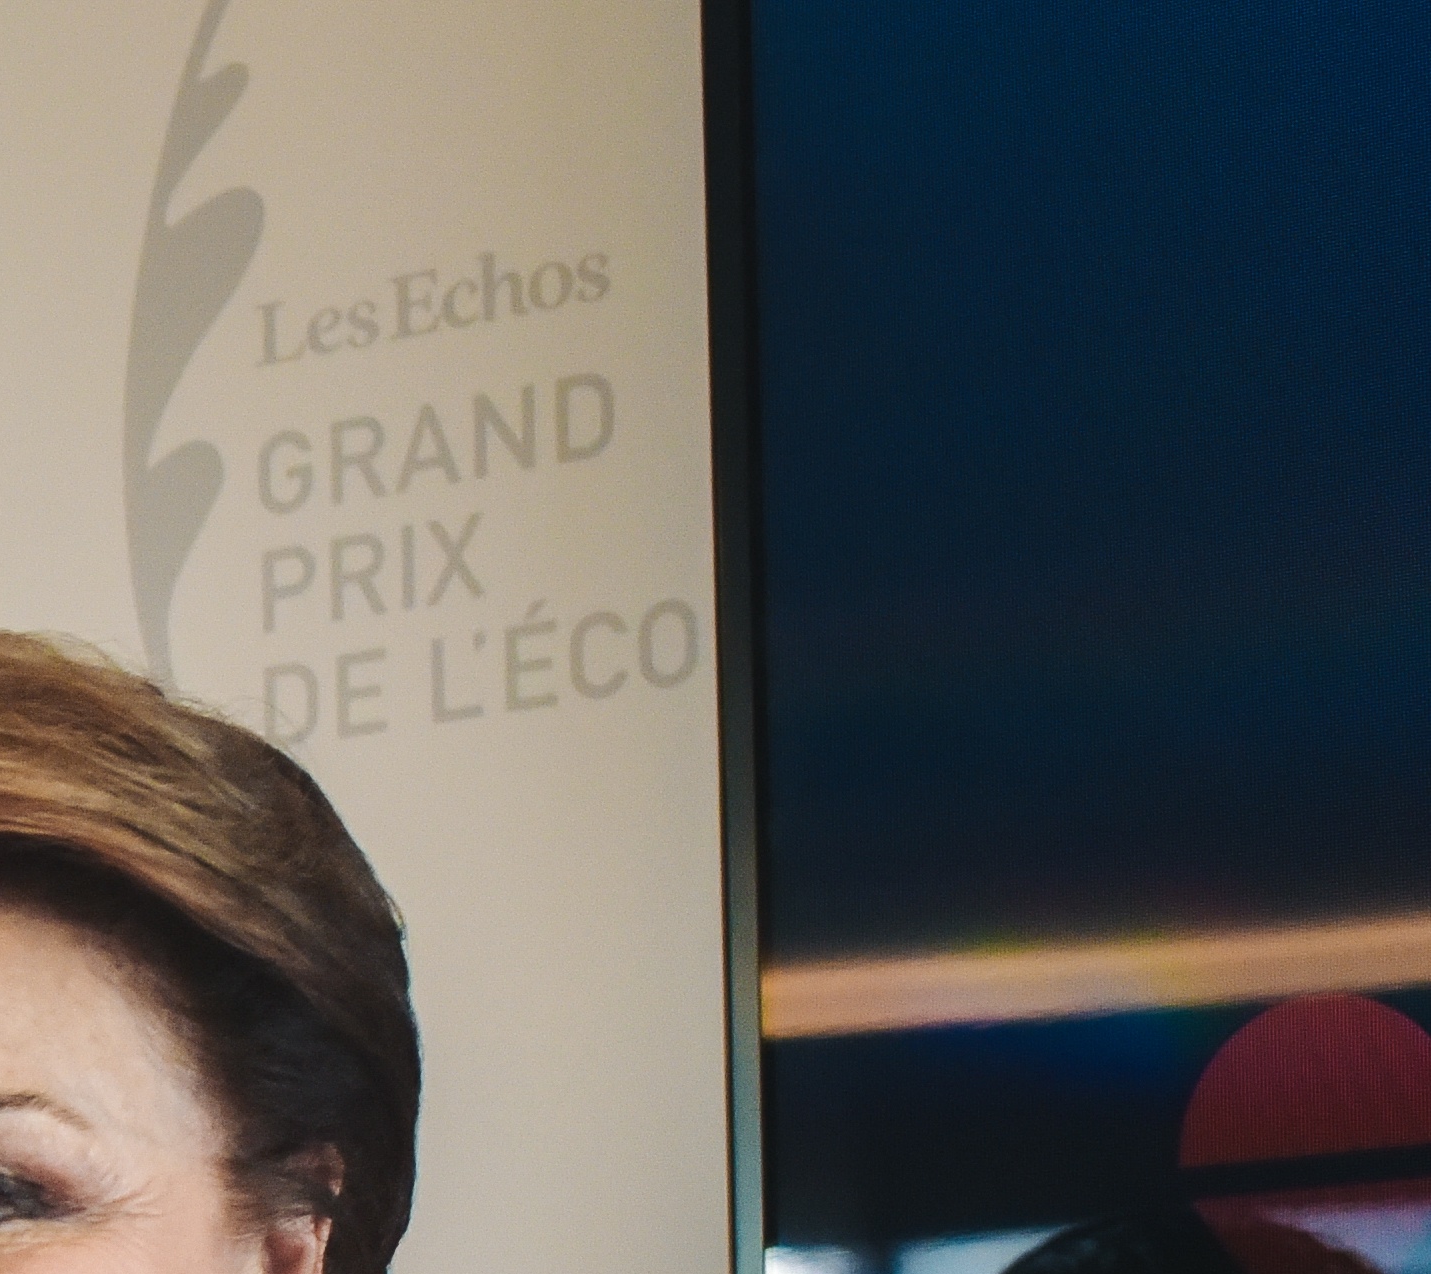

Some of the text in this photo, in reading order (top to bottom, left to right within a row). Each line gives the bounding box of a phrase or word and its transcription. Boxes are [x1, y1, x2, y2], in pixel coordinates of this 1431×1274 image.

[253, 248, 614, 369] Les Echos
[256, 370, 620, 517] GRAND
[261, 511, 487, 635] PRIX
[263, 595, 702, 748] DE L'ÉCO
